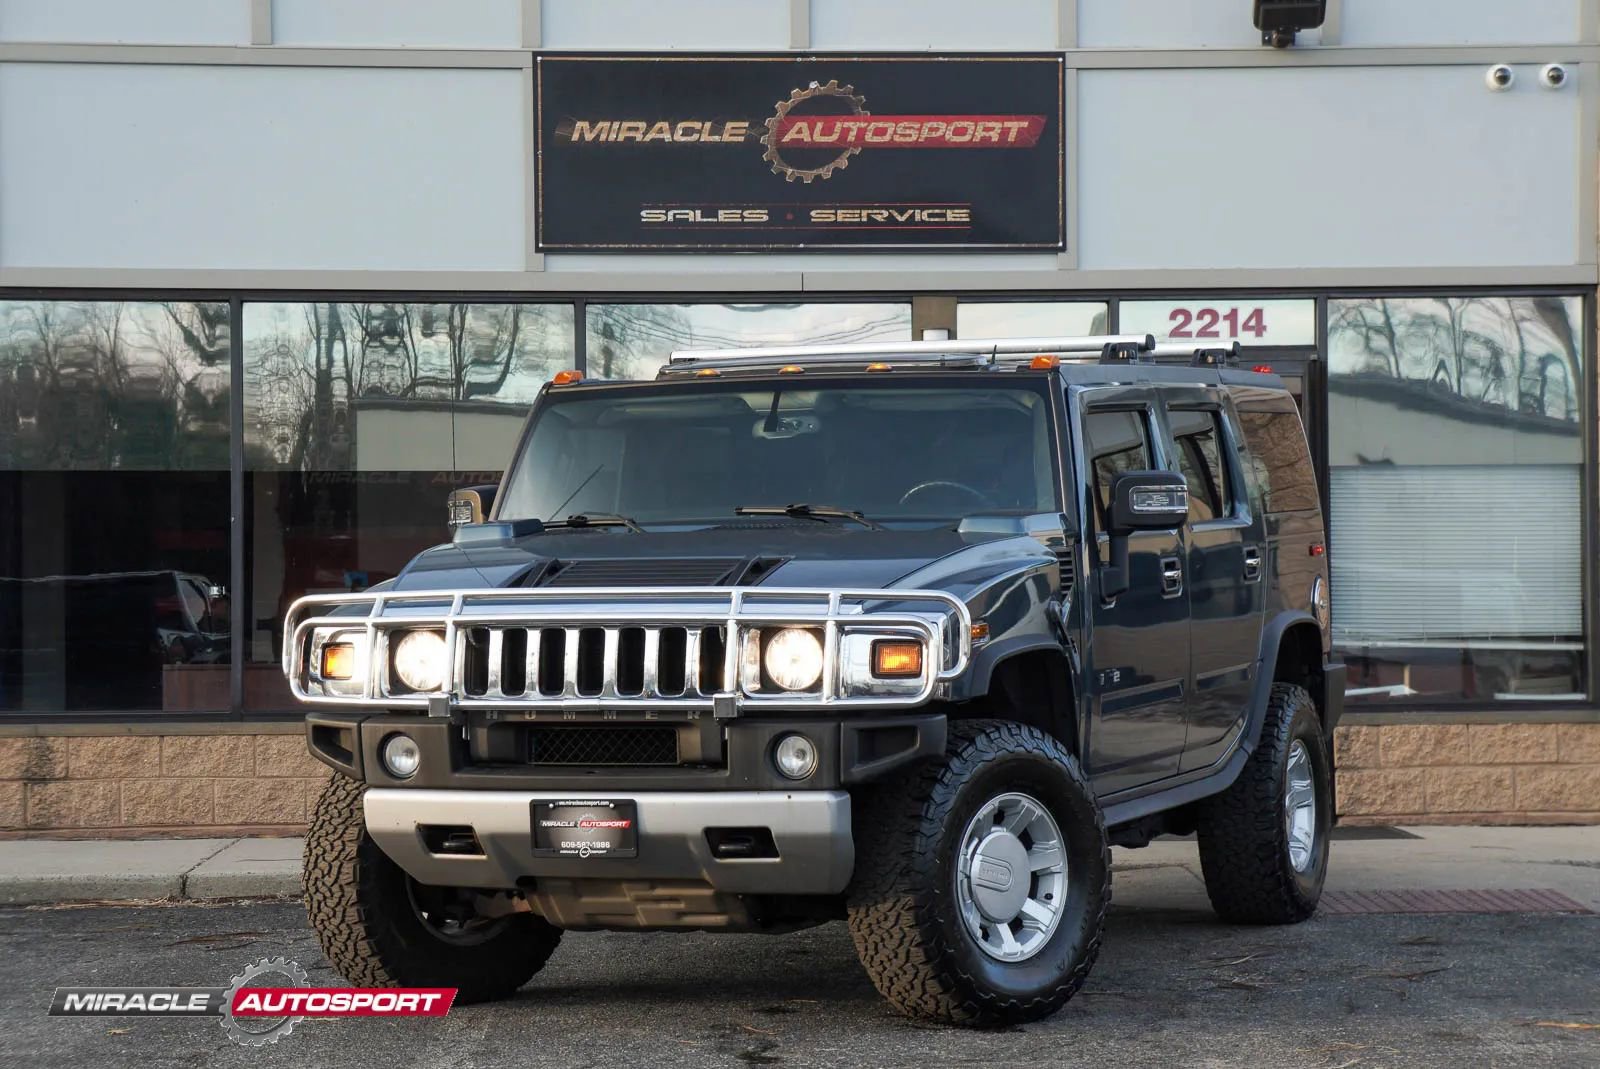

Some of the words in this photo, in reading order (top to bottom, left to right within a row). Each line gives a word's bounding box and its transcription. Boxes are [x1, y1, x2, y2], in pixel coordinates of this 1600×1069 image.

[570, 120, 751, 143] MIRACLE
[780, 120, 1030, 143] AUTOSPORT
[640, 208, 770, 223] SALES
[809, 207, 971, 223] SERVICE
[1168, 307, 1267, 338] 2214
[486, 710, 700, 720] HUMMER
